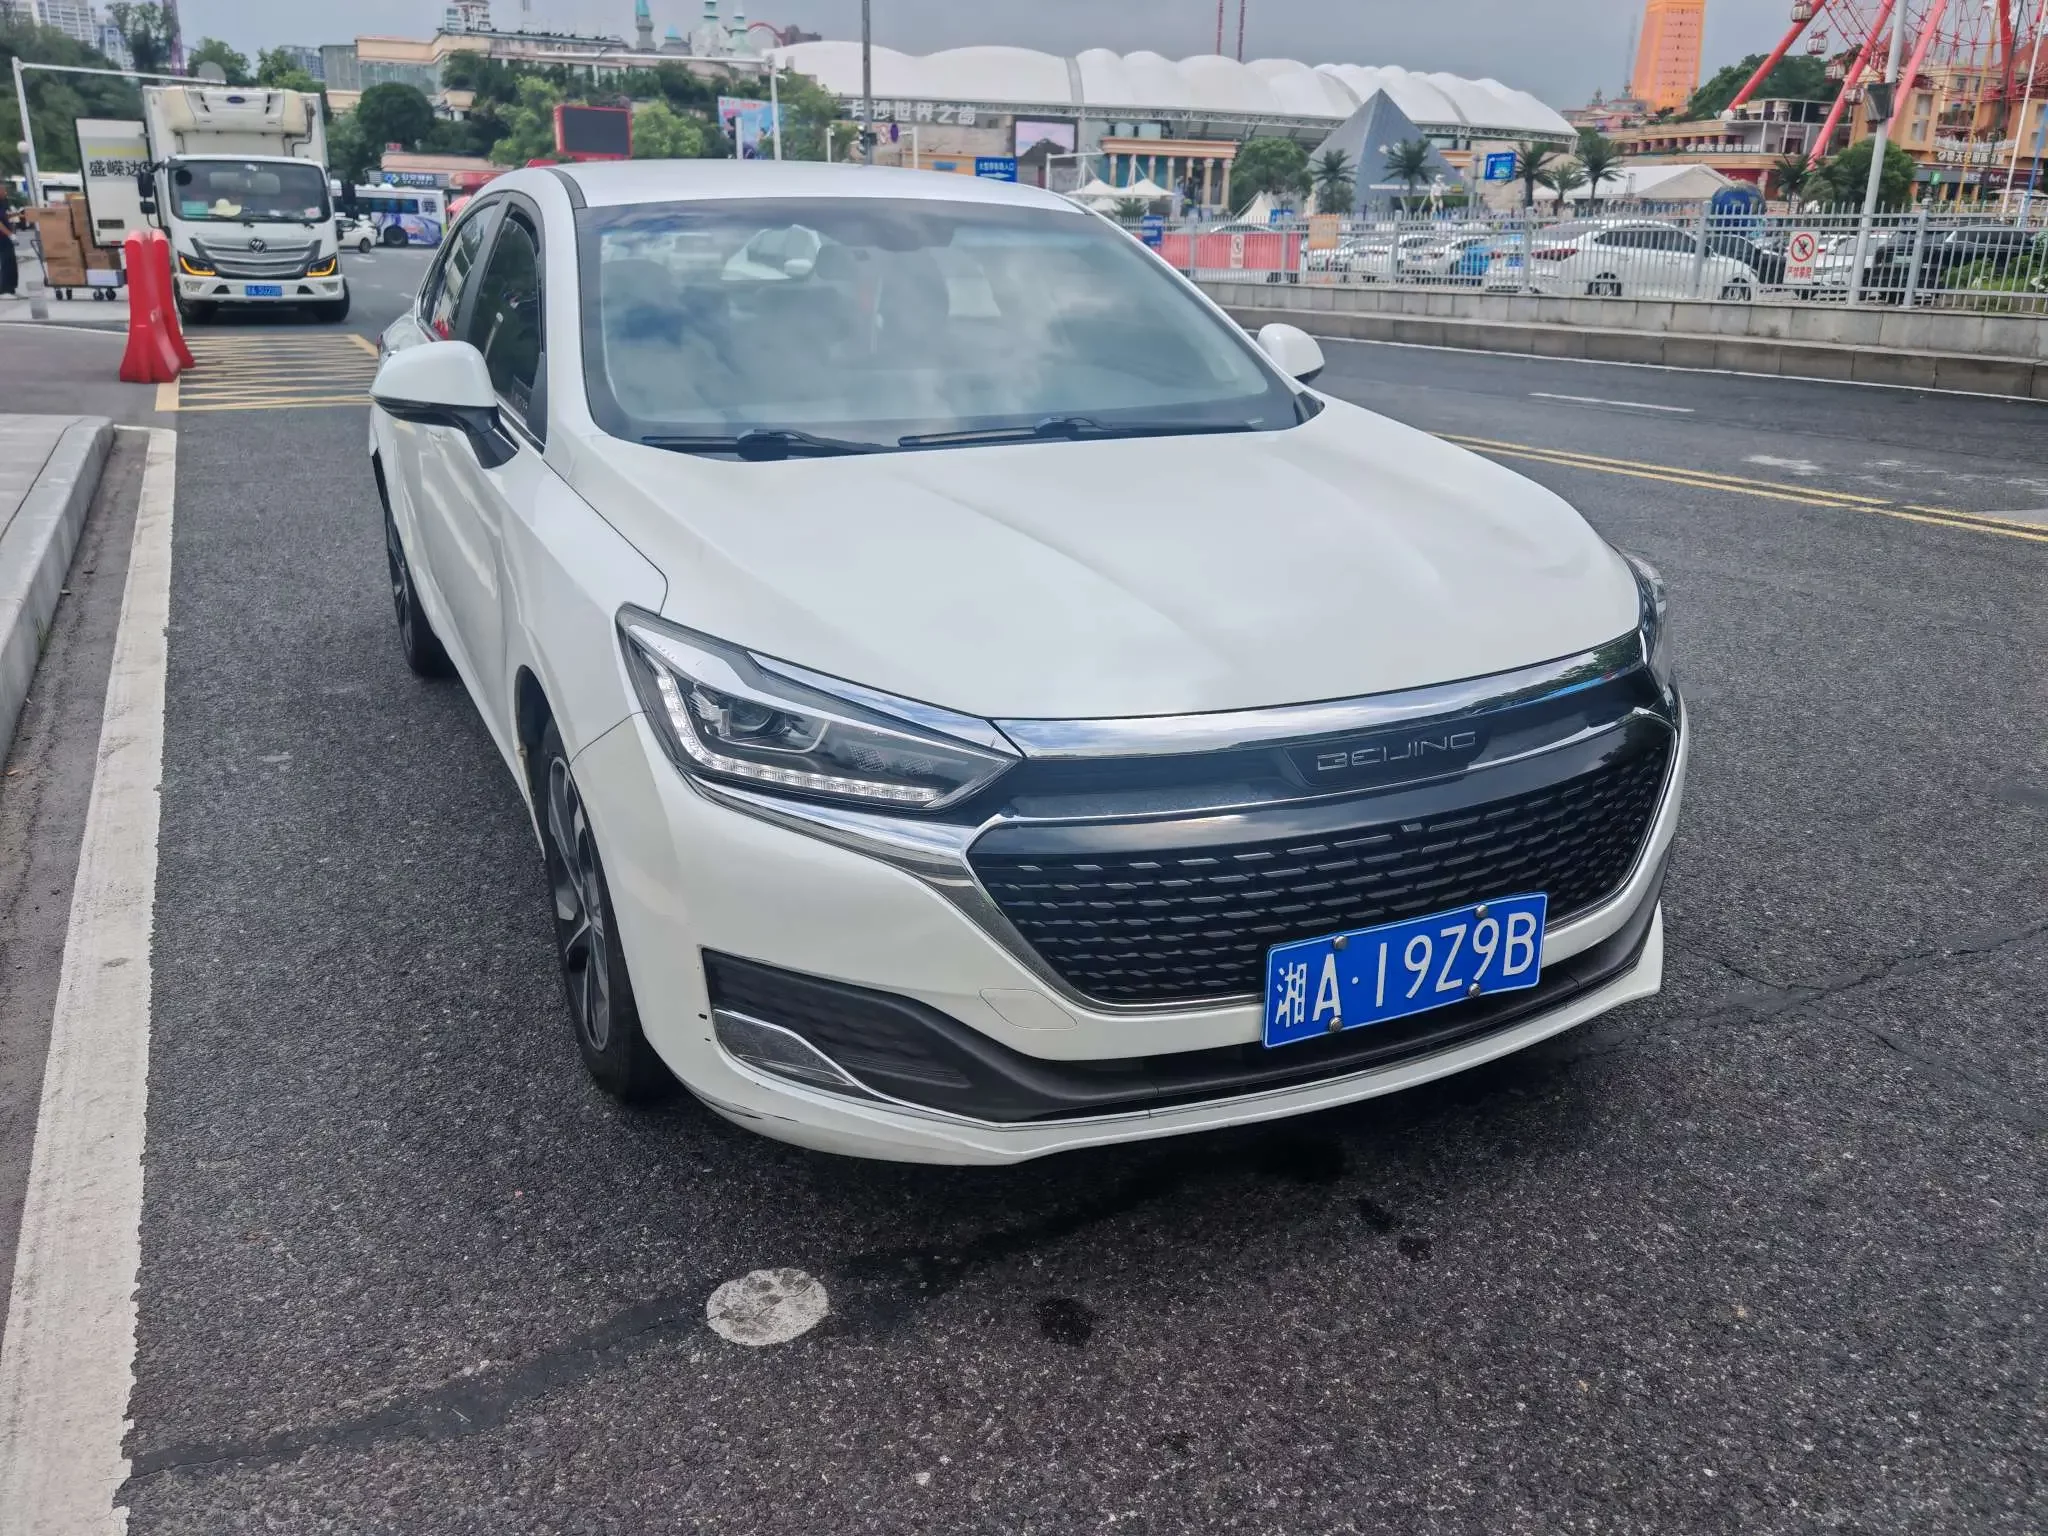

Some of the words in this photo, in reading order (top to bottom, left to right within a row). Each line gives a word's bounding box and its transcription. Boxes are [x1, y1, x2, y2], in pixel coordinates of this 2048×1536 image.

[852, 99, 977, 125] 长沙世界之窗
[1316, 731, 1476, 771] BEIJING
